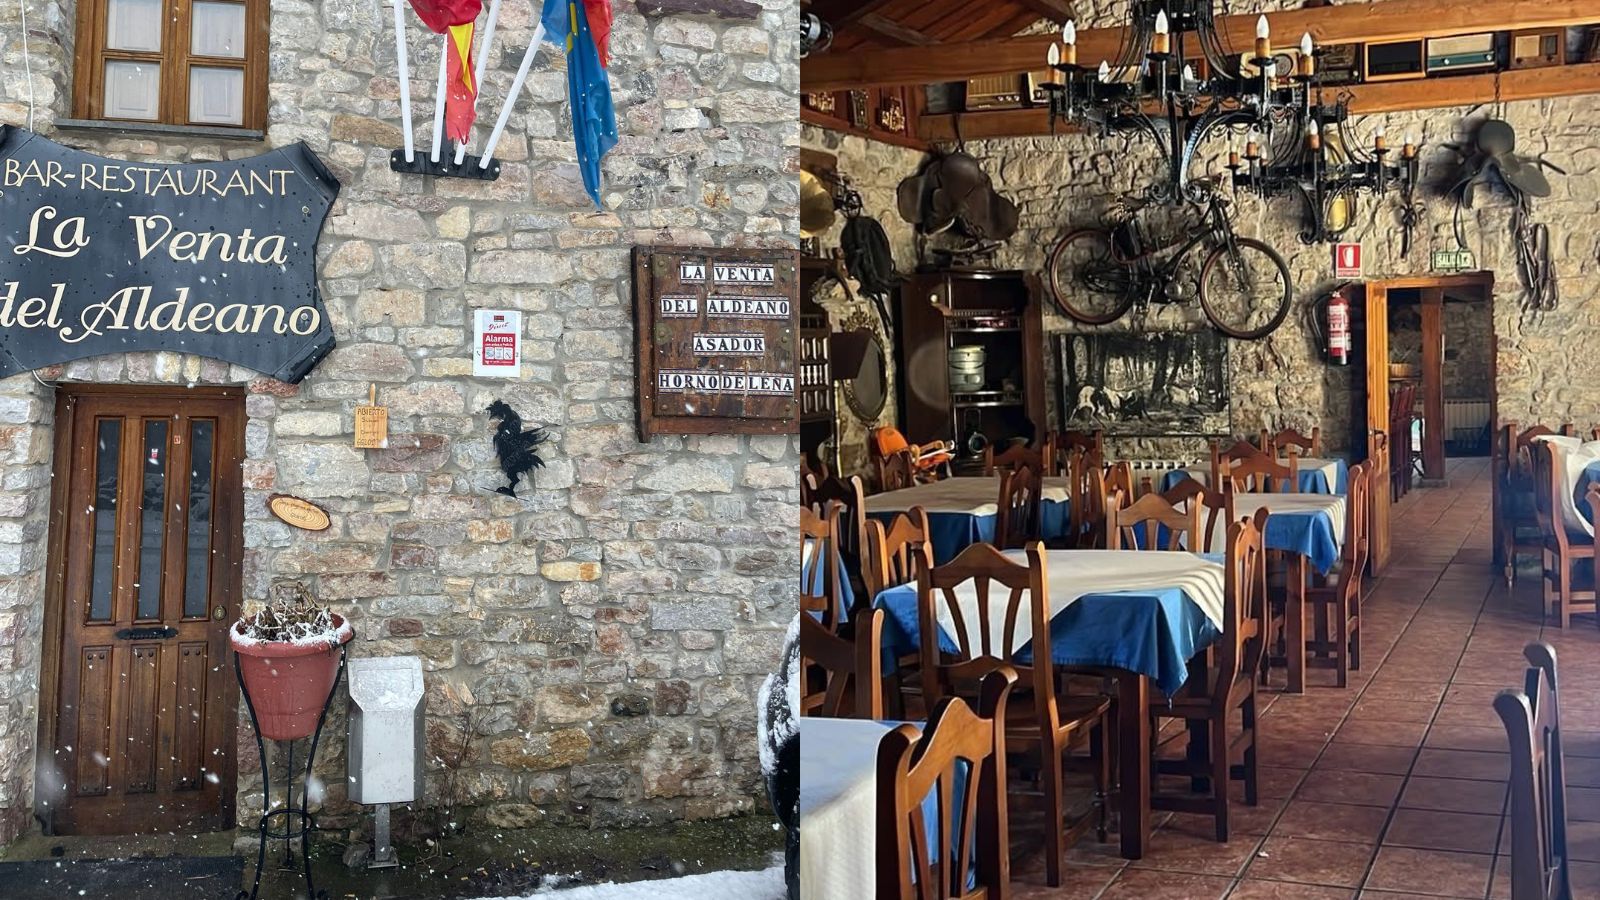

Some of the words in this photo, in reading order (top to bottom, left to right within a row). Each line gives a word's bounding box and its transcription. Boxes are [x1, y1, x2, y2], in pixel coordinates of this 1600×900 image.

[4, 160, 294, 196] BAR-RESTAURANT
[14, 206, 90, 257] La
[129, 215, 287, 264] Venta
[682, 266, 704, 279] LA
[715, 267, 773, 281] VENTA
[59, 286, 321, 343] Aldeano
[663, 301, 696, 313] DEL
[708, 301, 788, 315] ALDEANO
[485, 335, 513, 343] Alarma
[695, 339, 763, 351] ASADOR
[659, 374, 718, 389] HORNO
[722, 376, 744, 390] DE
